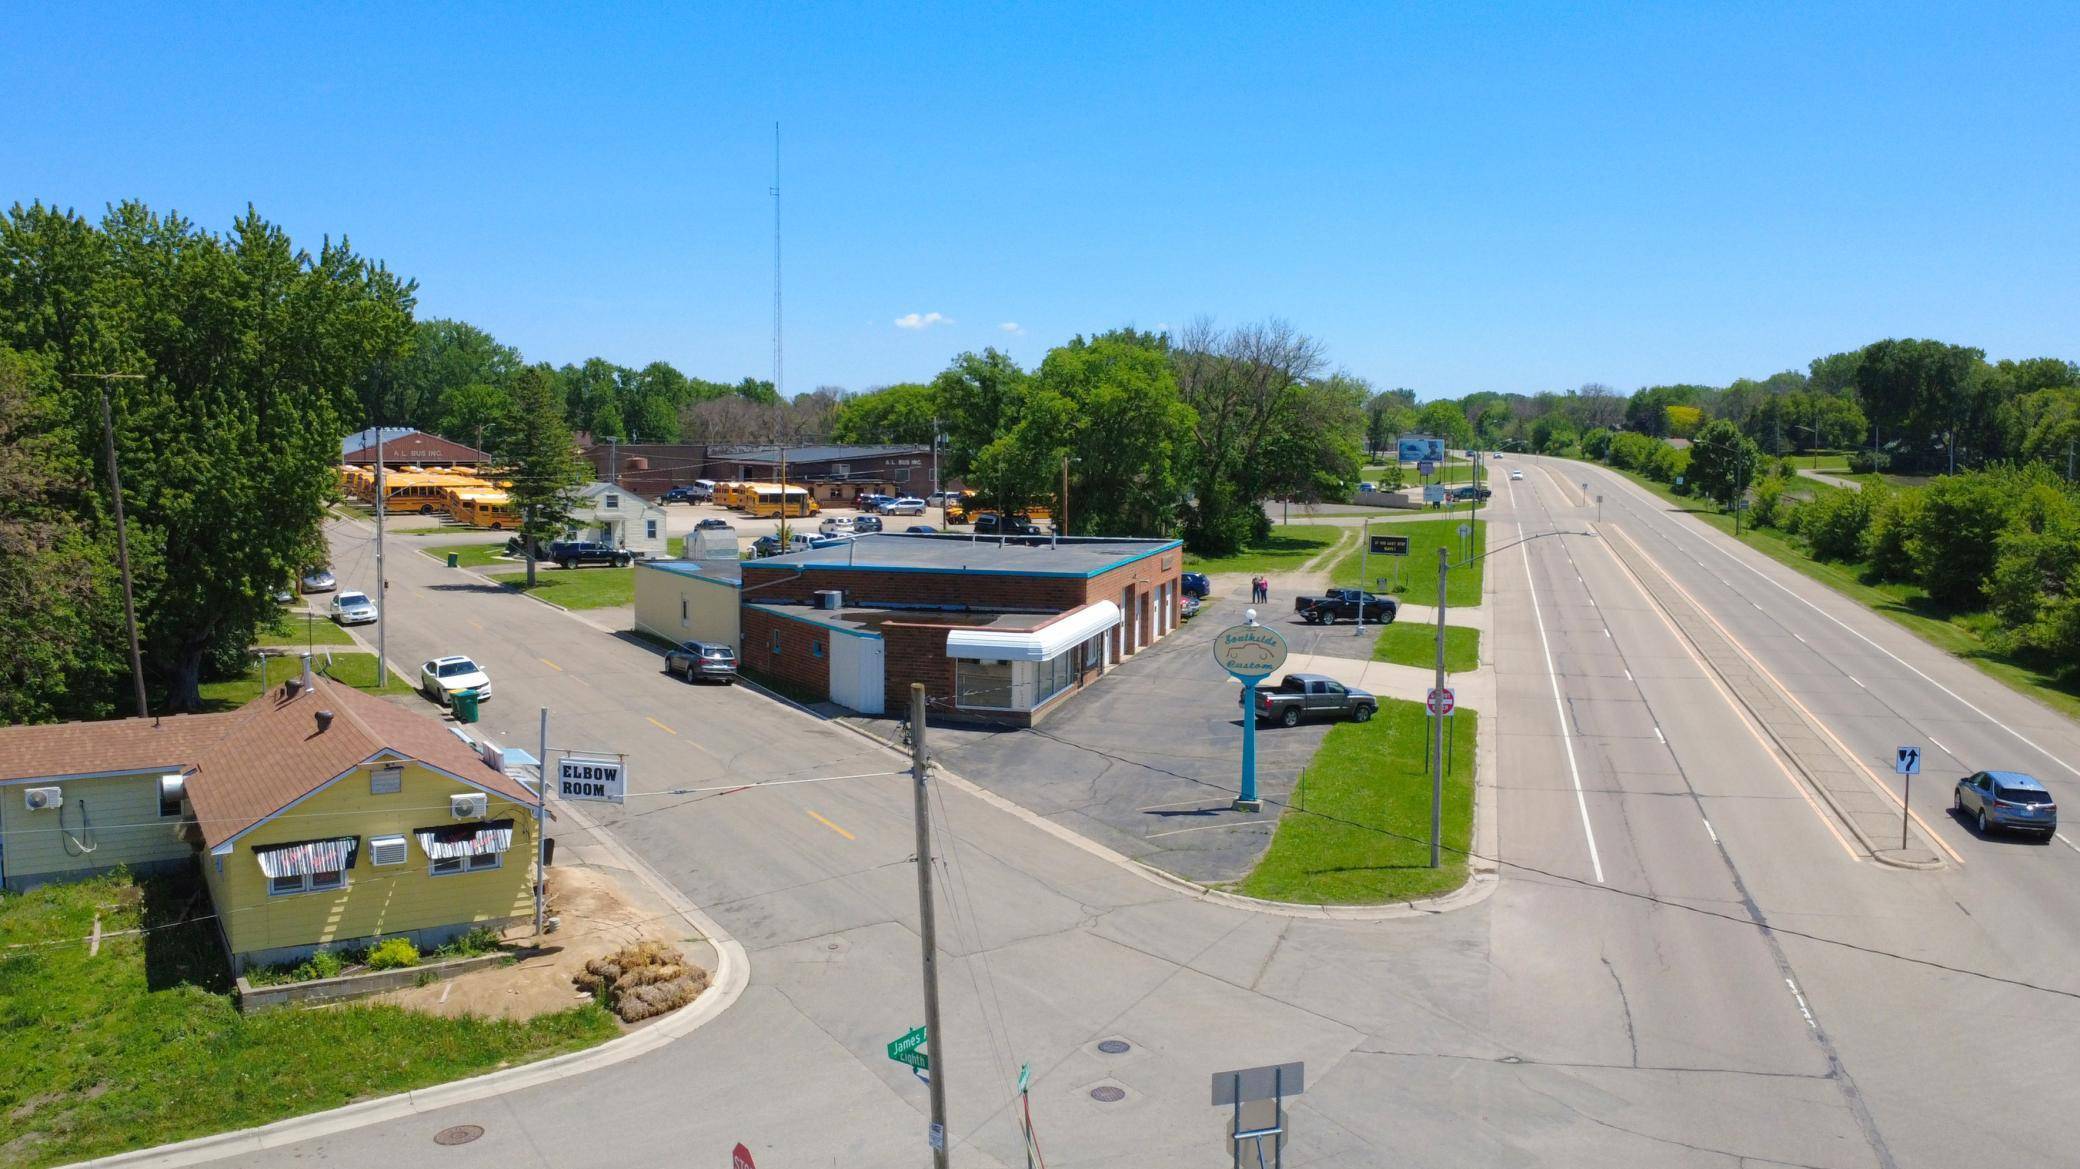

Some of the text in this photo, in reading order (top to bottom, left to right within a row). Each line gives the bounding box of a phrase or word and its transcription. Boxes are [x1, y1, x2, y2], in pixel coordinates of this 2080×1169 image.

[1225, 633, 1276, 647] Southside
[563, 765, 617, 781] ELBOW
[563, 781, 605, 797] ROOM
[893, 1033, 921, 1055] James
